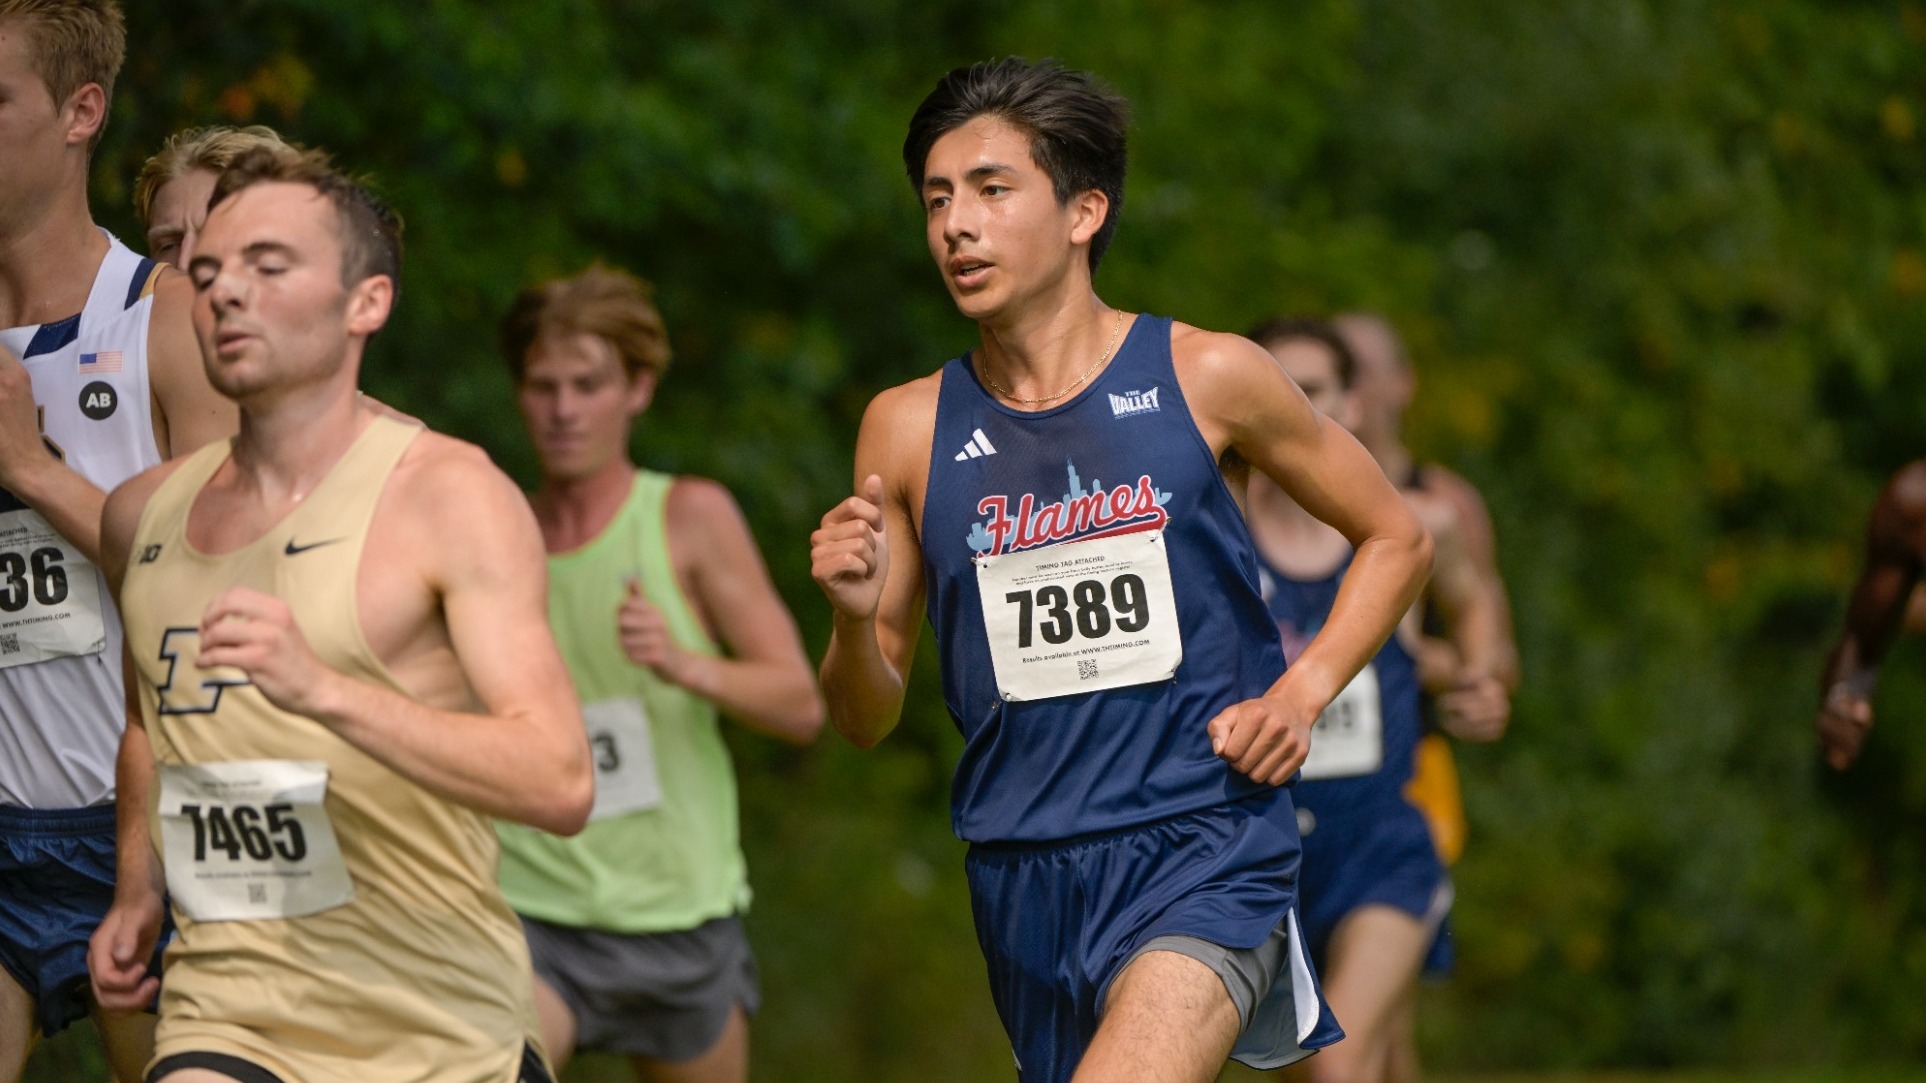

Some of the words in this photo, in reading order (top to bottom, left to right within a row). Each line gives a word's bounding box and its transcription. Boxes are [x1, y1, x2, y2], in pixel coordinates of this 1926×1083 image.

[86, 392, 111, 408] AB
[1108, 387, 1159, 415] VALLEY
[977, 474, 1167, 558] Flames
[1006, 573, 1150, 649] 7389
[181, 803, 308, 863] 7465
